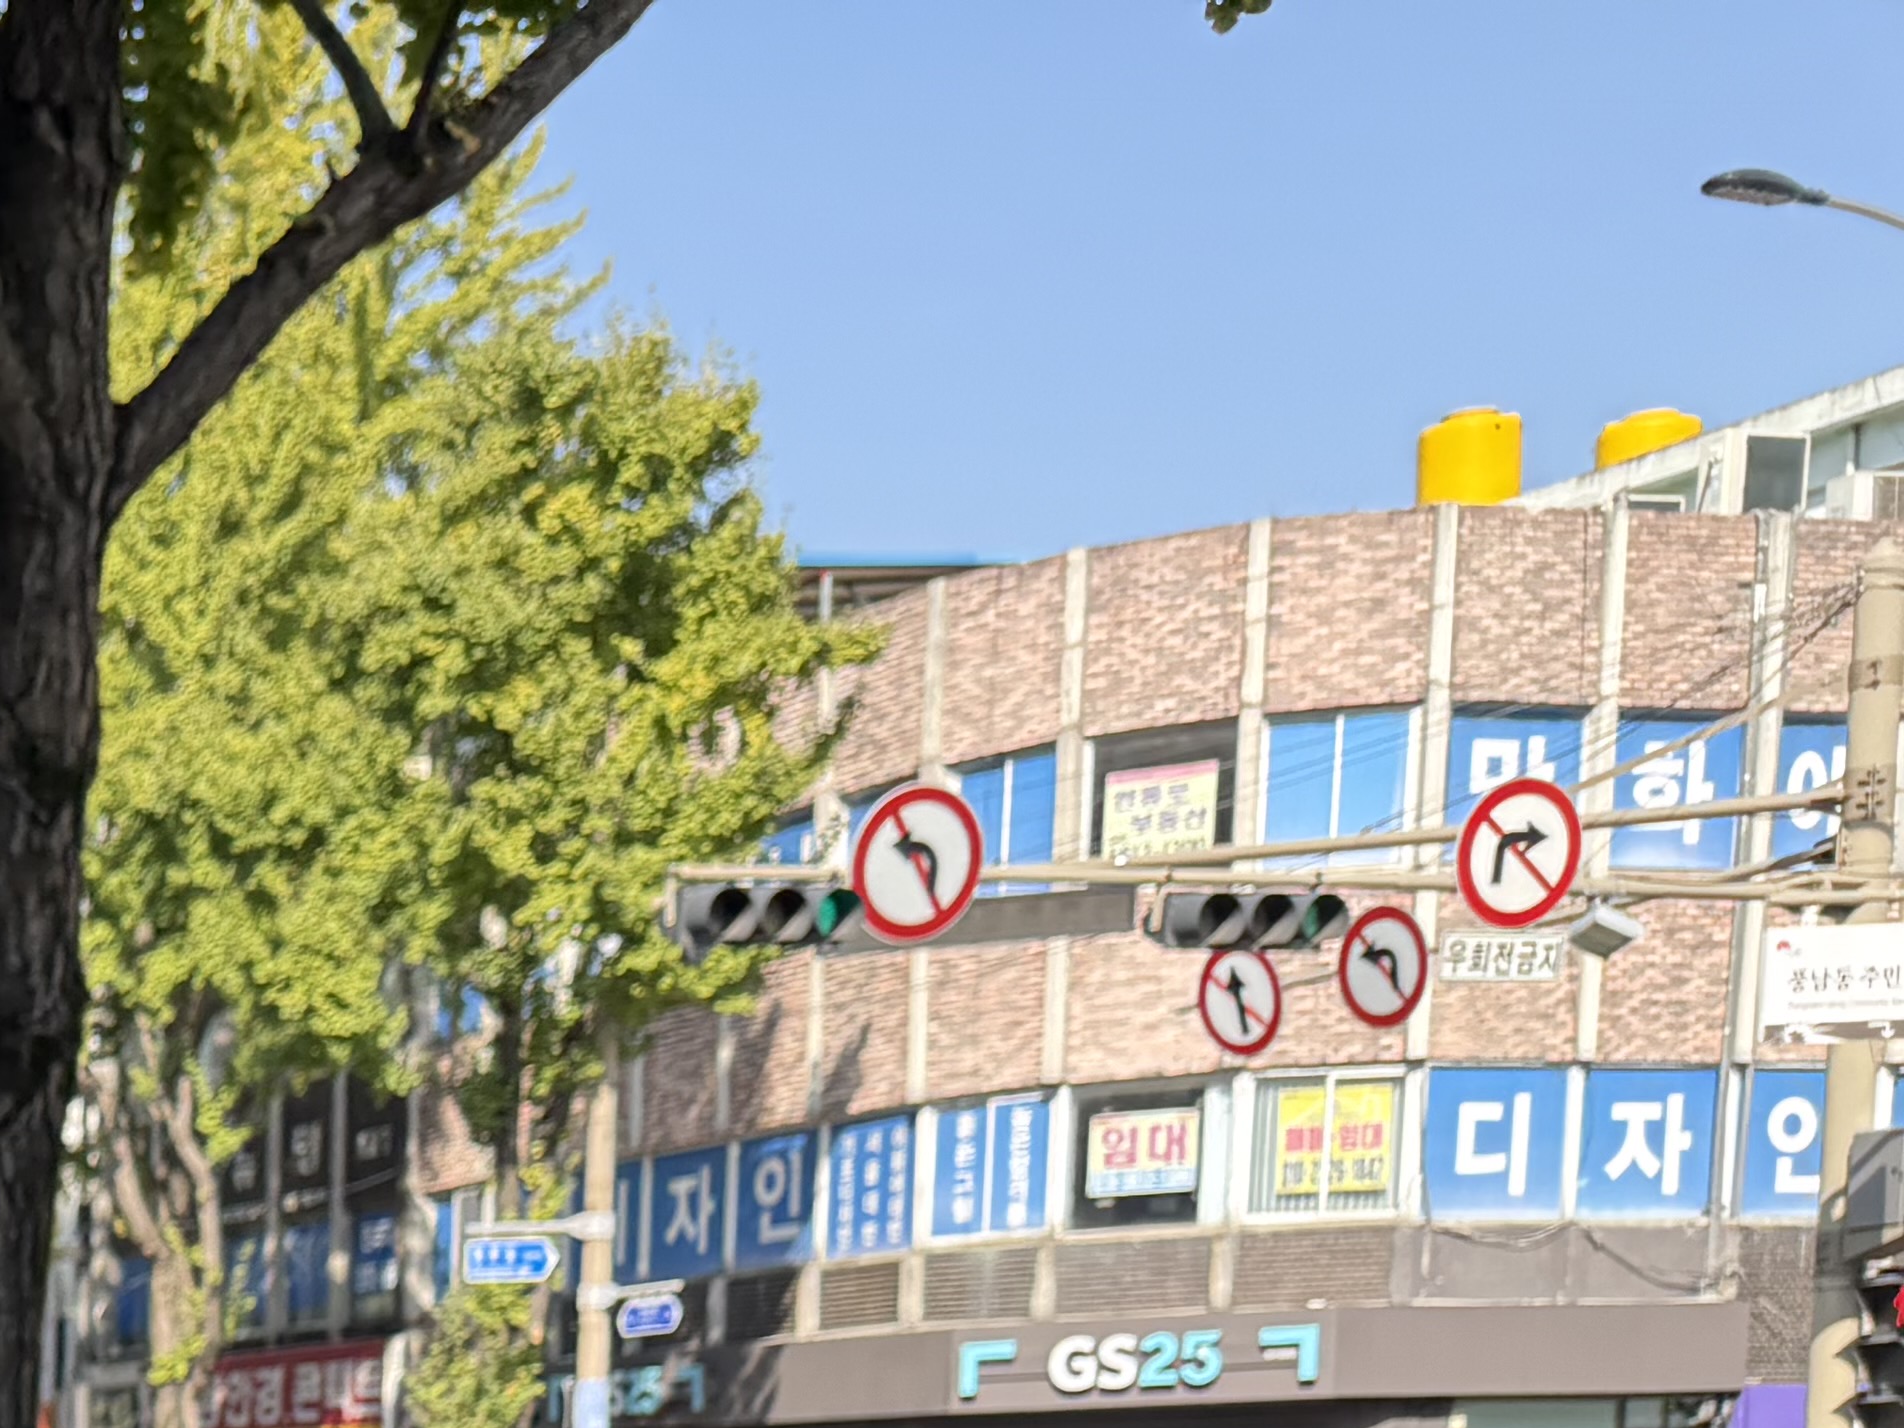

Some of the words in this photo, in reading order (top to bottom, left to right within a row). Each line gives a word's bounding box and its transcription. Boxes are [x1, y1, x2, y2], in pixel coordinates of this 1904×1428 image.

[1444, 938, 1564, 976] 우회전금지
[1788, 965, 1854, 993] 풍남동
[1101, 1122, 1188, 1169] 임대
[1454, 1091, 1821, 1197] 디자인
[1048, 1329, 1224, 1393] GS25
